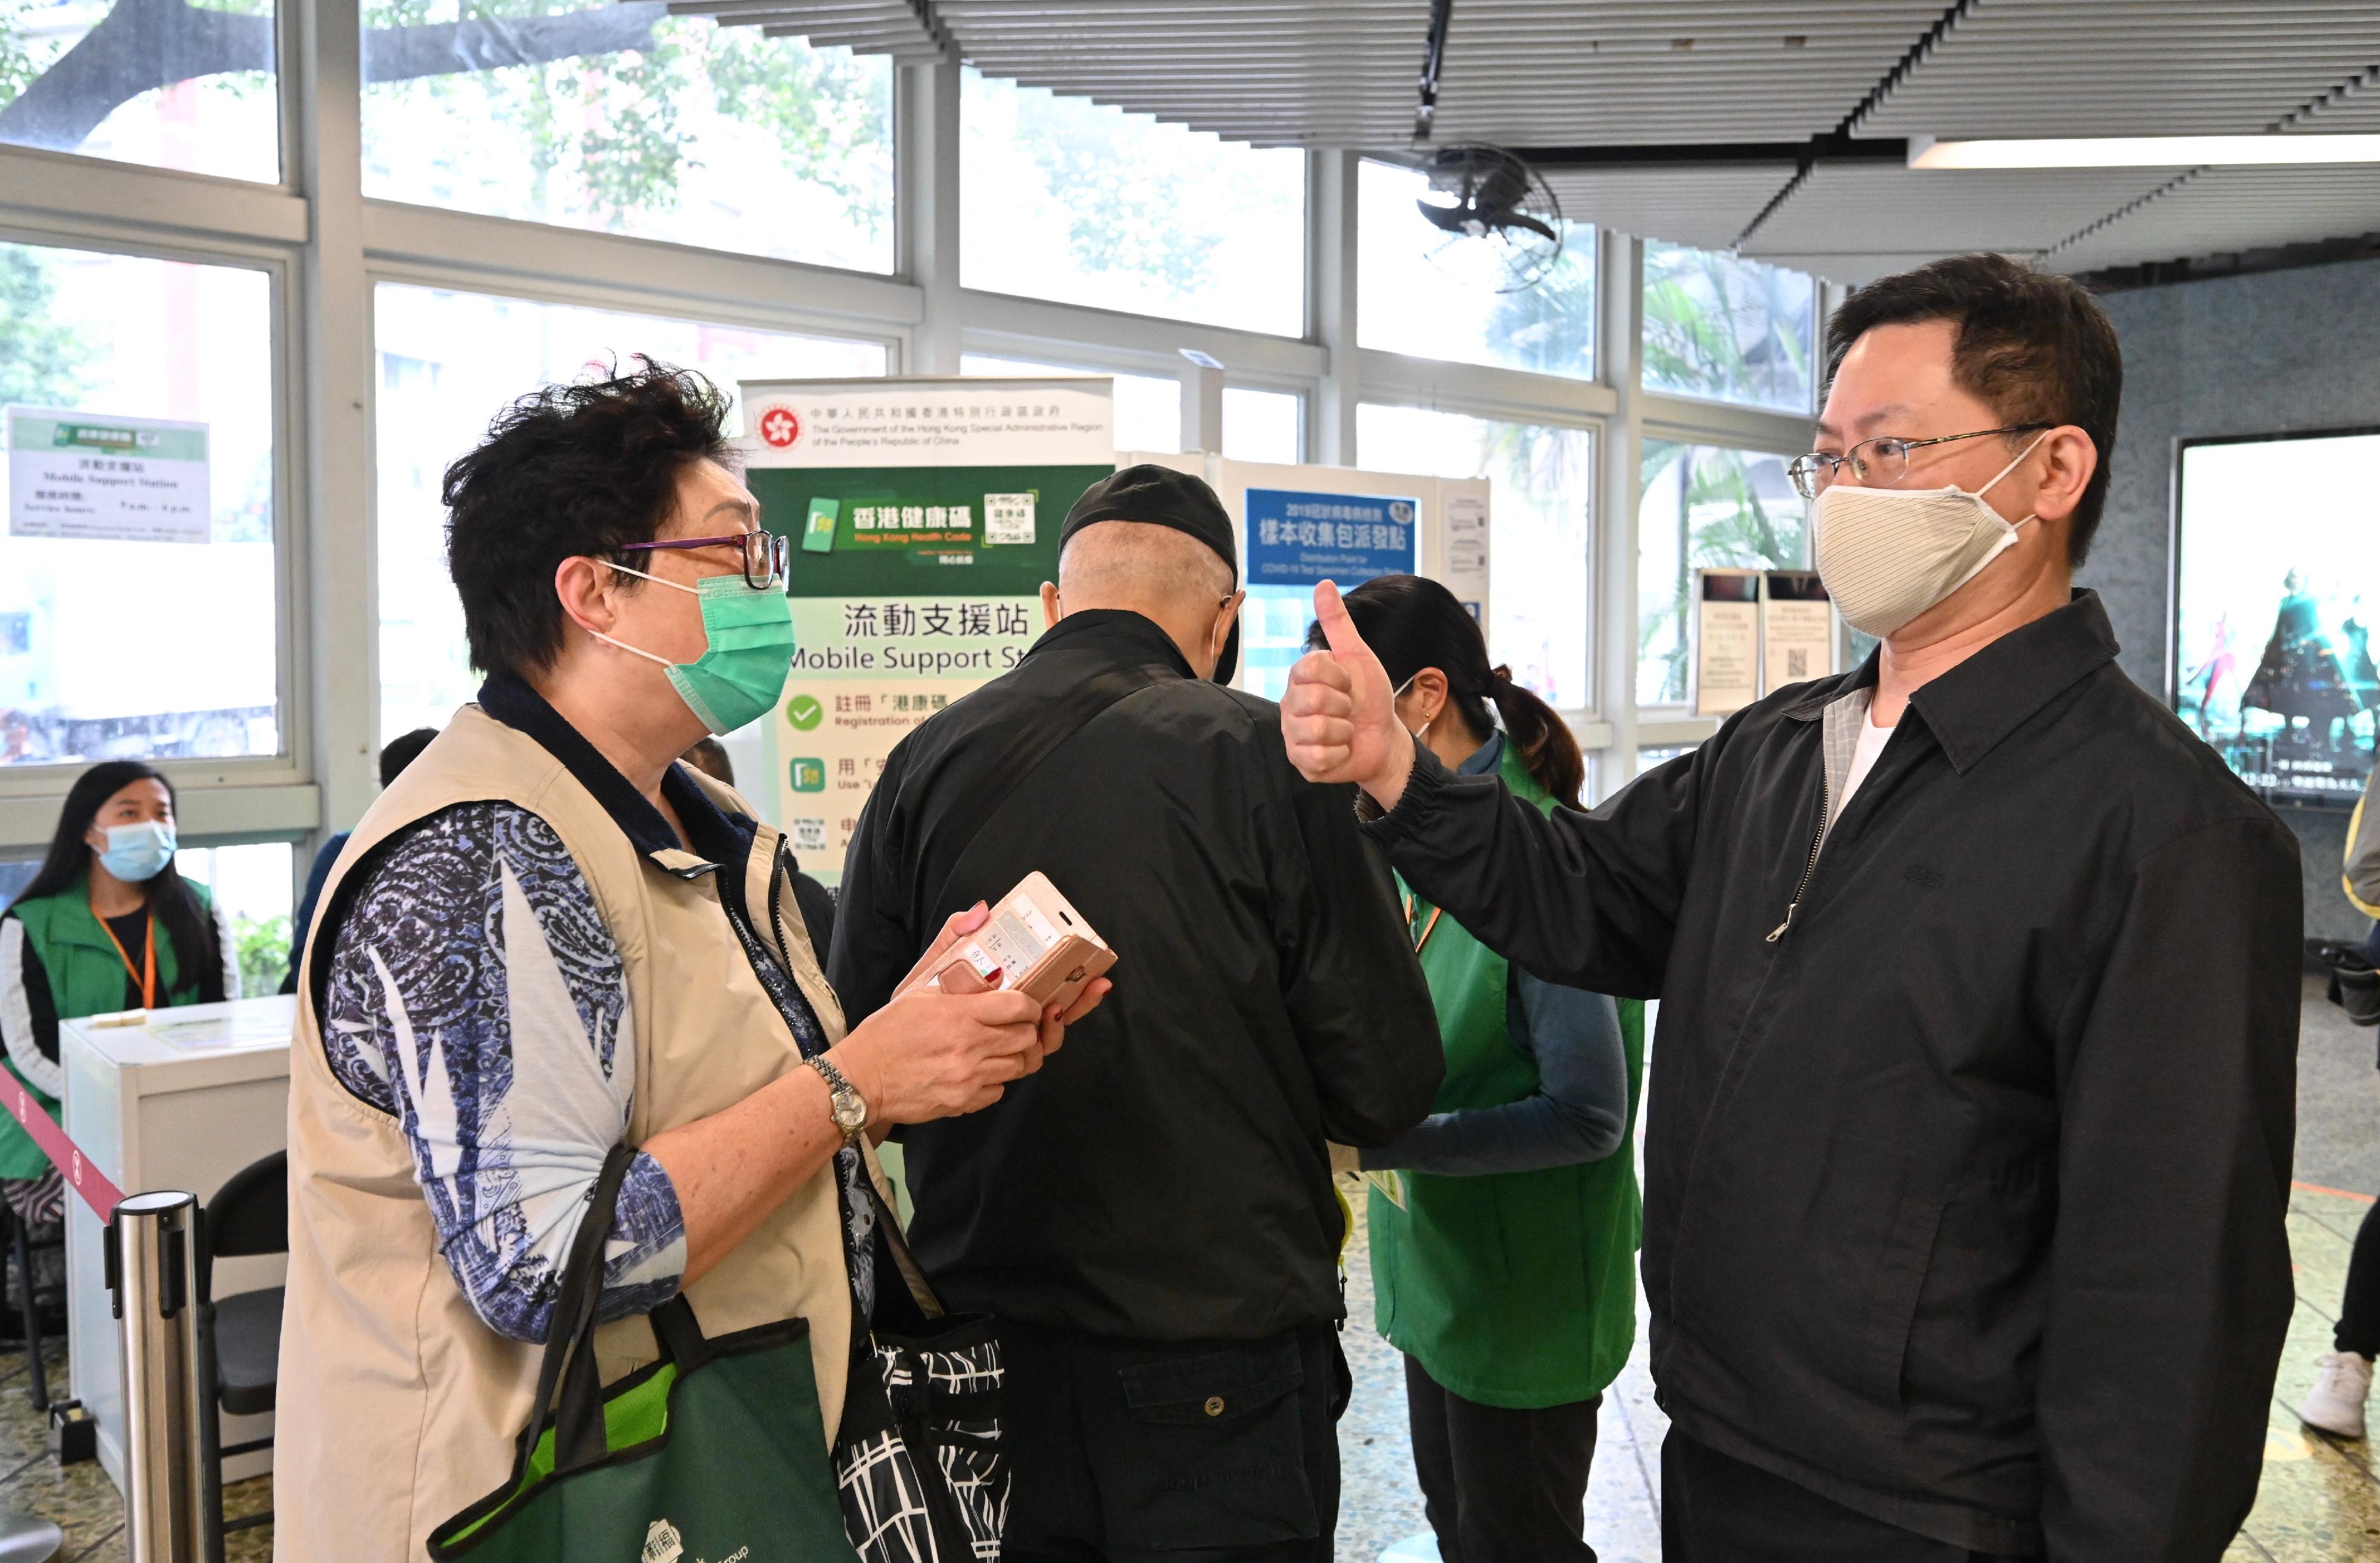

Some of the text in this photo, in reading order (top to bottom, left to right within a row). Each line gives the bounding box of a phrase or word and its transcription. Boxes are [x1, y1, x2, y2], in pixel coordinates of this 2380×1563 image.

[813, 422, 1104, 434] The Government of the Hong Kong Special Administrative Region
[812, 438, 821, 446] of
[823, 437, 838, 446] the
[881, 437, 919, 447] Republic
[922, 437, 931, 446] of
[932, 437, 960, 446] China
[43, 472, 178, 489] Mobile Support Station
[853, 506, 972, 530] 香港健康碼
[1259, 518, 1407, 551] 樣本收集包派發點
[844, 603, 1029, 637] 流動支援站
[791, 647, 874, 669] Mobile
[884, 647, 992, 675] Support
[835, 716, 910, 729] Registration
[838, 781, 860, 790] Use
